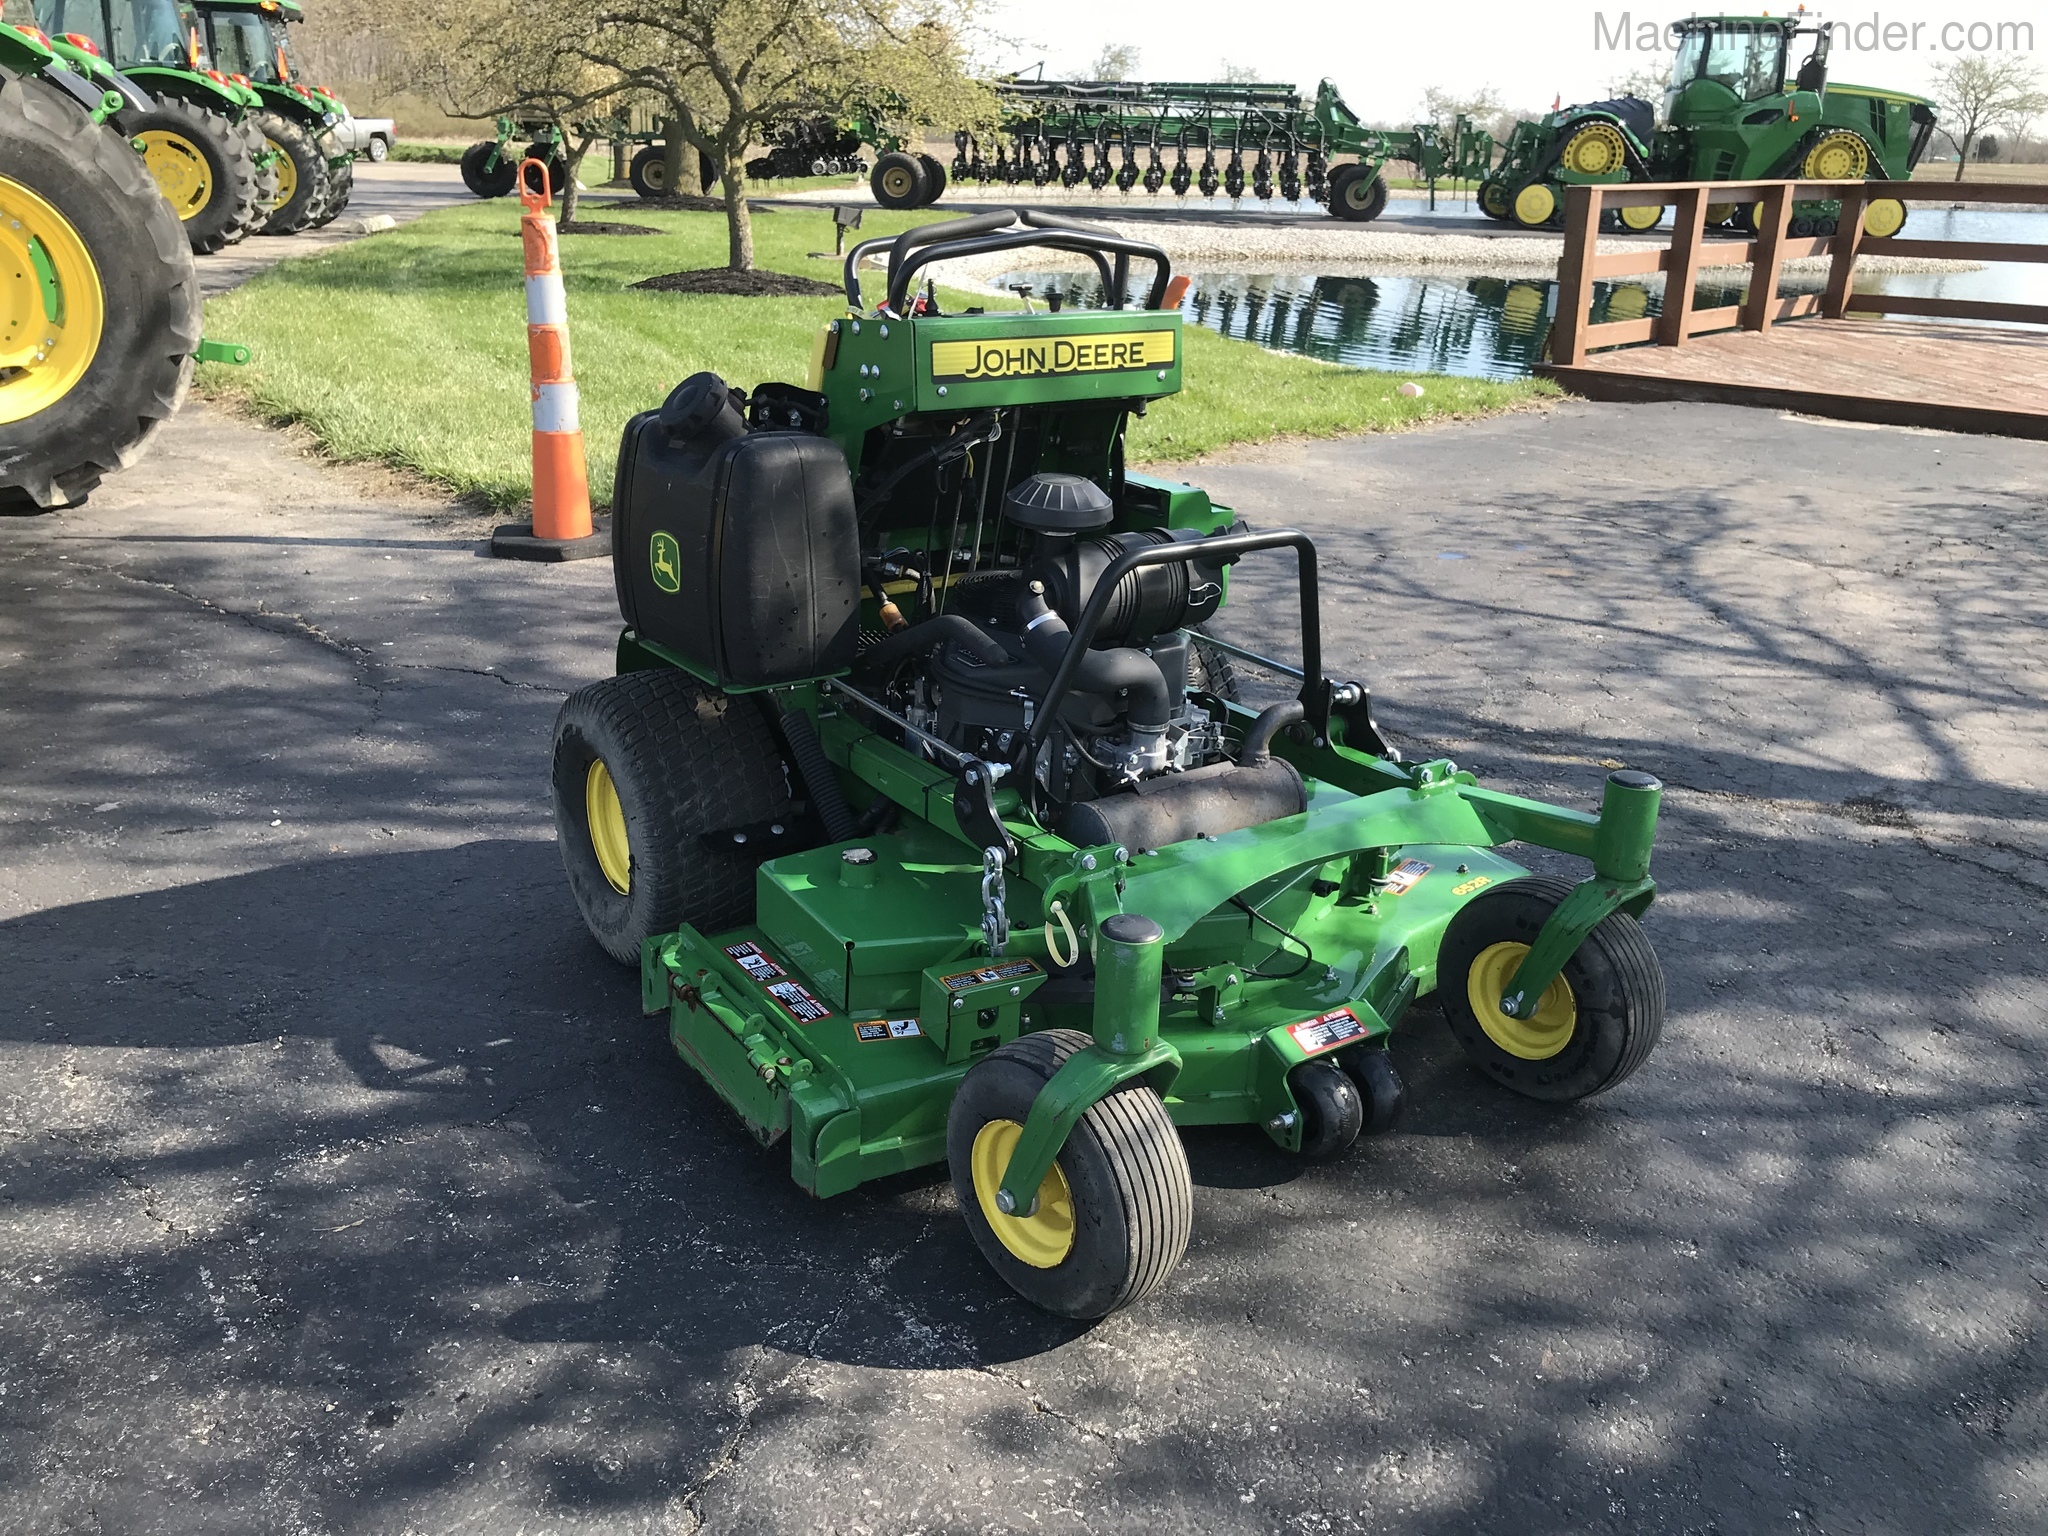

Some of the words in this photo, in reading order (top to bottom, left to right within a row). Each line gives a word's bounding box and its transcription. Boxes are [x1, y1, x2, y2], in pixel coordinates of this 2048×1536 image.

[965, 345, 1046, 375] JOHN
[1054, 340, 1145, 369] DEERE
[1451, 876, 1493, 896] 652R
